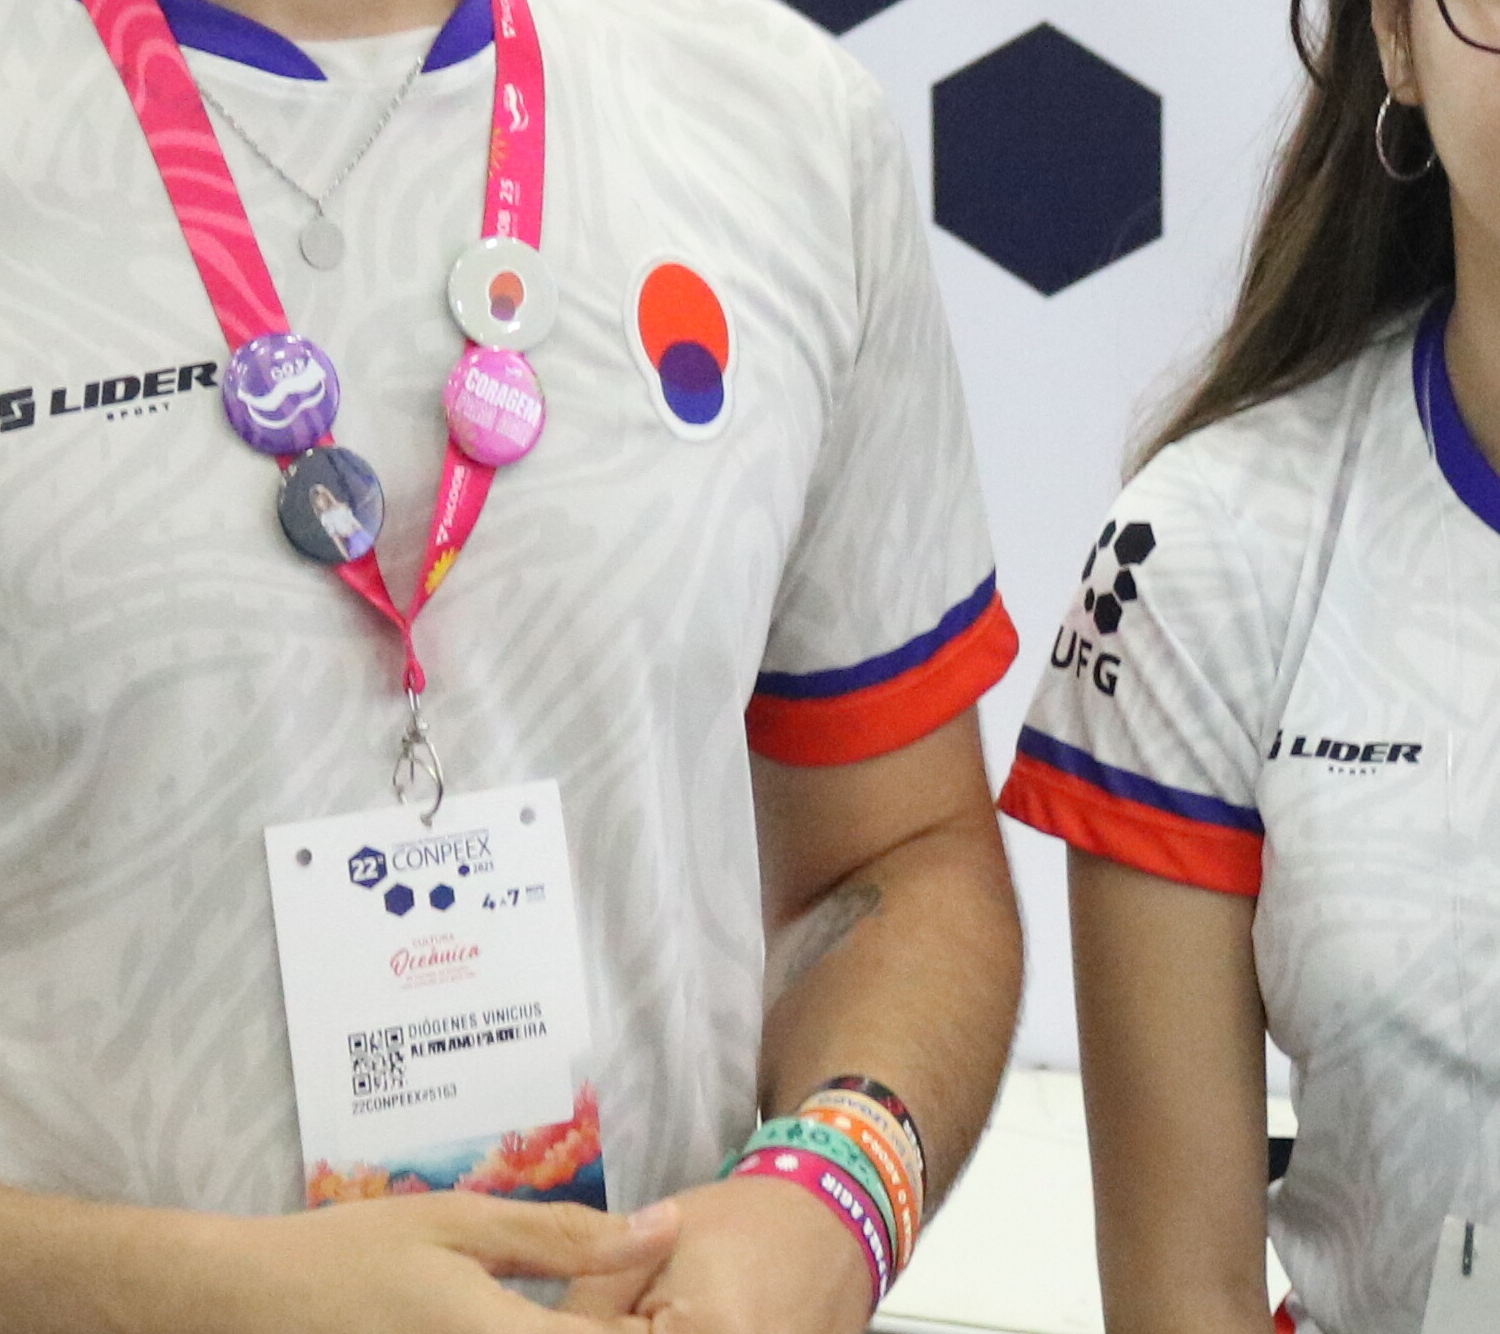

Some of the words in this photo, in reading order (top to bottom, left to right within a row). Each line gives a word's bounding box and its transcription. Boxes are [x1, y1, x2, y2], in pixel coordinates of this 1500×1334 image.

[50, 363, 217, 416] LIDER
[1050, 626, 1121, 696] UFG
[1290, 736, 1423, 764] LIDER
[393, 836, 493, 872] CONPEEX
[408, 1014, 478, 1039] DIÓGENES
[483, 1002, 543, 1026] VINICIUS
